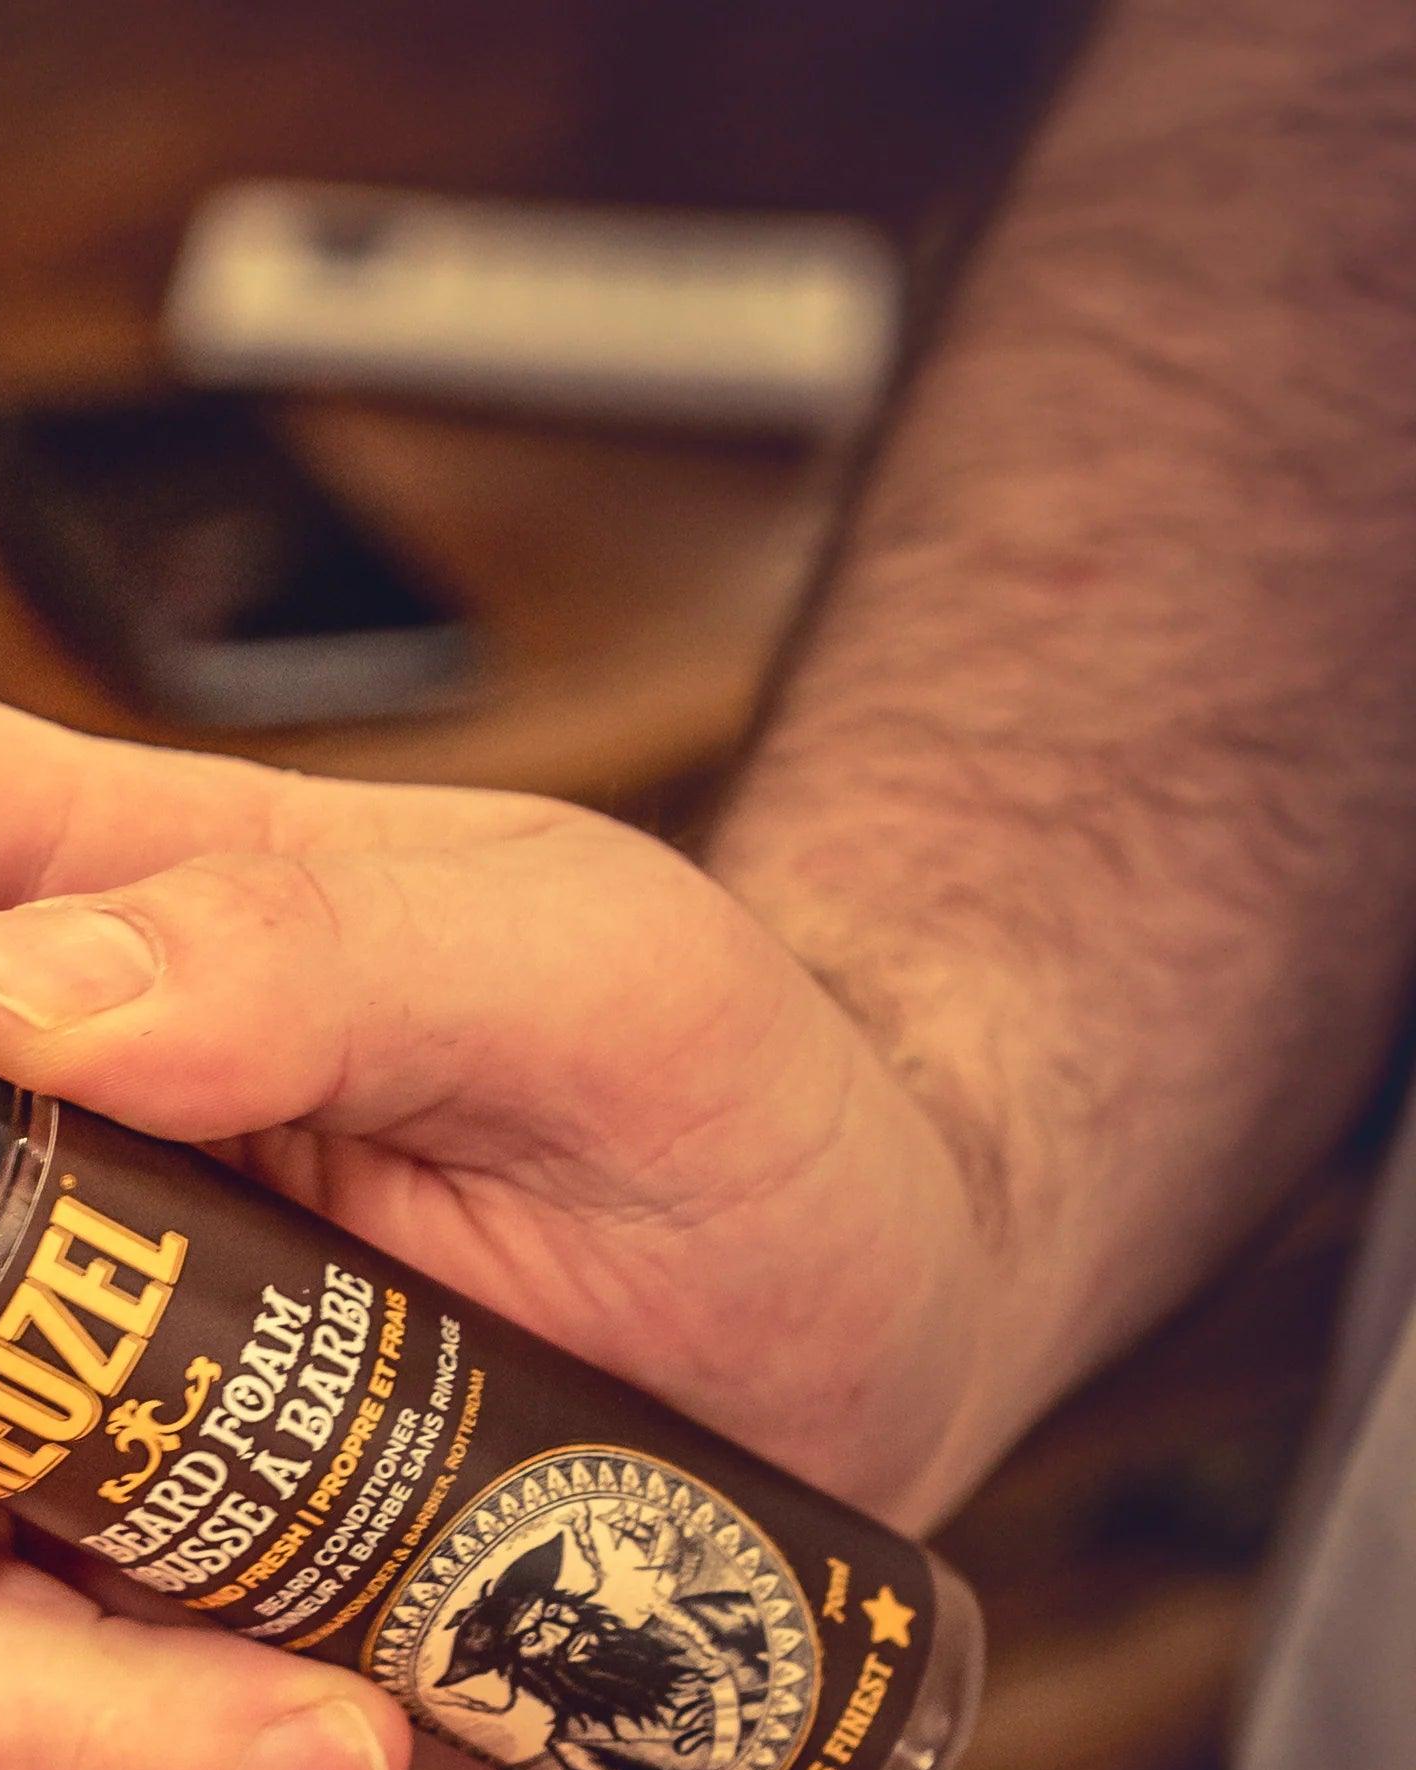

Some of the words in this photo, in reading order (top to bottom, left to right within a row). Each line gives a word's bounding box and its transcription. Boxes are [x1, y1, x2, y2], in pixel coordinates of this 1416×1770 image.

[275, 1263, 374, 1451] BARBE
[379, 1287, 408, 1361] FRAIS
[80, 1451, 229, 1564] BEARD
[199, 1285, 313, 1457] FOAM
[368, 1358, 398, 1401] ET
[445, 1368, 486, 1471] ROTTERDAM
[239, 1449, 313, 1500] À
[308, 1397, 385, 1512] PROPRE
[334, 1564, 361, 1587] A
[348, 1481, 414, 1562] BARBE
[402, 1412, 446, 1482] SANS
[429, 1315, 461, 1412] RINCAGE
[120, 1492, 279, 1592] OUSSE
[236, 1523, 313, 1589] FRESH
[254, 1567, 321, 1617] BEARD
[313, 1407, 422, 1567] CONDITIONER
[822, 1652, 894, 1765] FINEST
